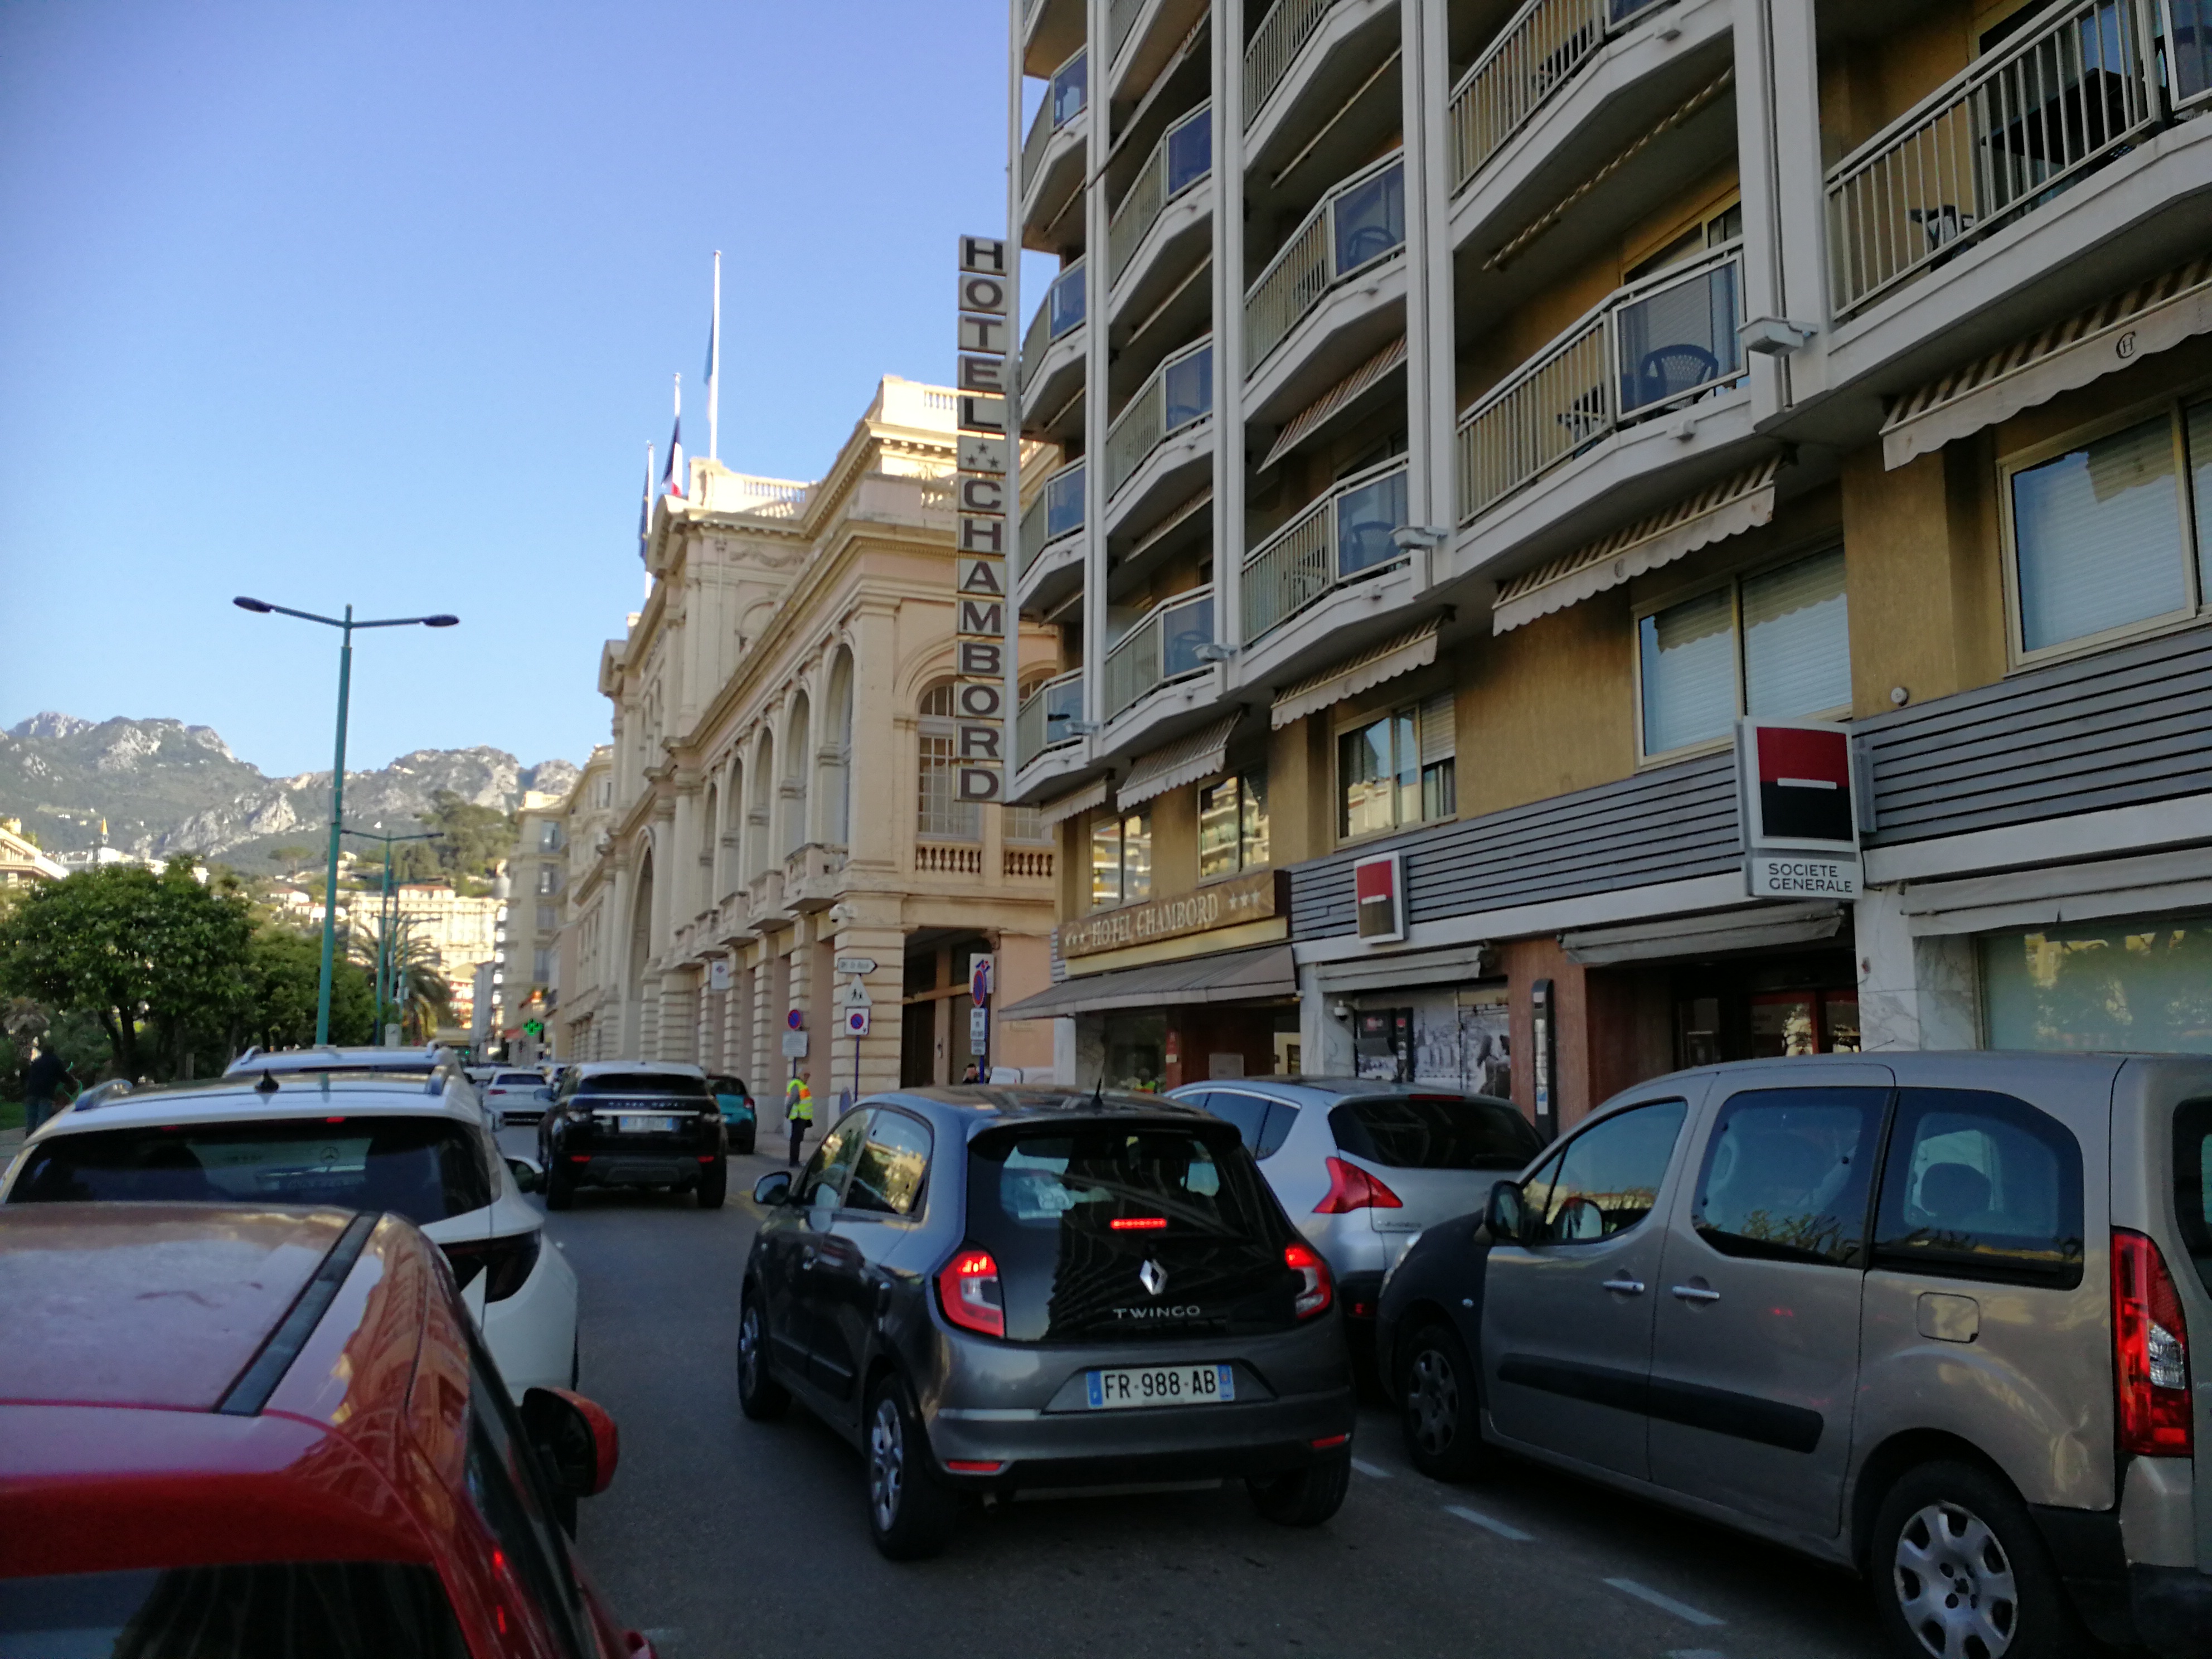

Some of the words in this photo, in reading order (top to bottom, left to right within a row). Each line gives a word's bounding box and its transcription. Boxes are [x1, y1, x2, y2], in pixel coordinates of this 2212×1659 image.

[964, 237, 1004, 429] HOTEL
[960, 479, 1002, 800] CHAMBORD
[1768, 863, 1839, 877] SOCIETE
[1769, 877, 1853, 893] GENERALE
[1092, 913, 1132, 947] HOTEL
[1136, 893, 1219, 938] CHAMBORD
[1113, 1304, 1201, 1320] TWINGO
